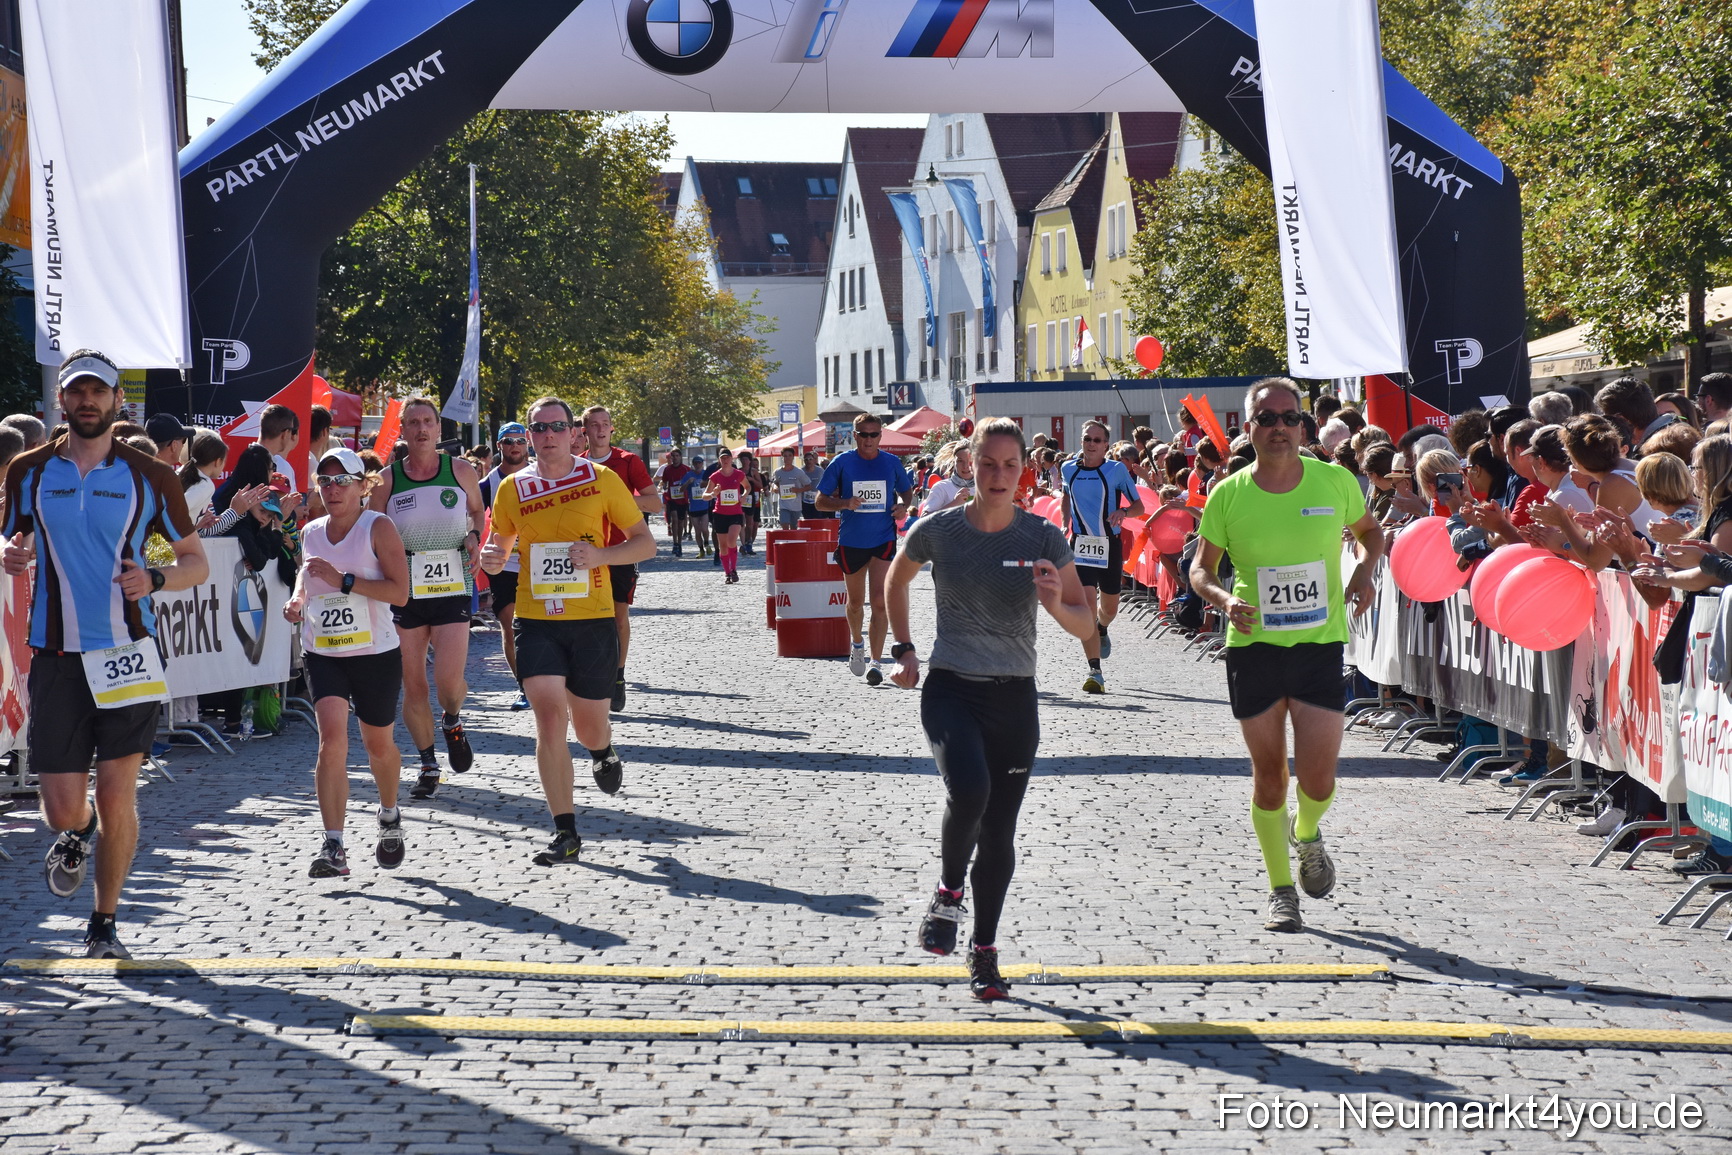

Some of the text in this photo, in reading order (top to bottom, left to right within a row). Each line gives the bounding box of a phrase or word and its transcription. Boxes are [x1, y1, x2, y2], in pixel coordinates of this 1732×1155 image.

[206, 49, 446, 203] PARTL NEUMARKT
[1051, 295, 1068, 314] HOTEL
[207, 414, 235, 426] NEXT
[1425, 415, 1447, 426] THE
[520, 485, 601, 517] MAX BÖGL
[858, 490, 882, 500] 2055
[1079, 544, 1105, 556] 2116
[424, 563, 450, 579] 241
[543, 558, 575, 576] 259
[1277, 570, 1308, 580] BOCK
[427, 585, 451, 593] Markus
[553, 585, 565, 593] Jiri
[1269, 580, 1319, 604] 2164
[156, 583, 222, 660] markt
[321, 608, 354, 628] 226
[328, 636, 354, 646] Marion
[104, 653, 147, 680] 332
